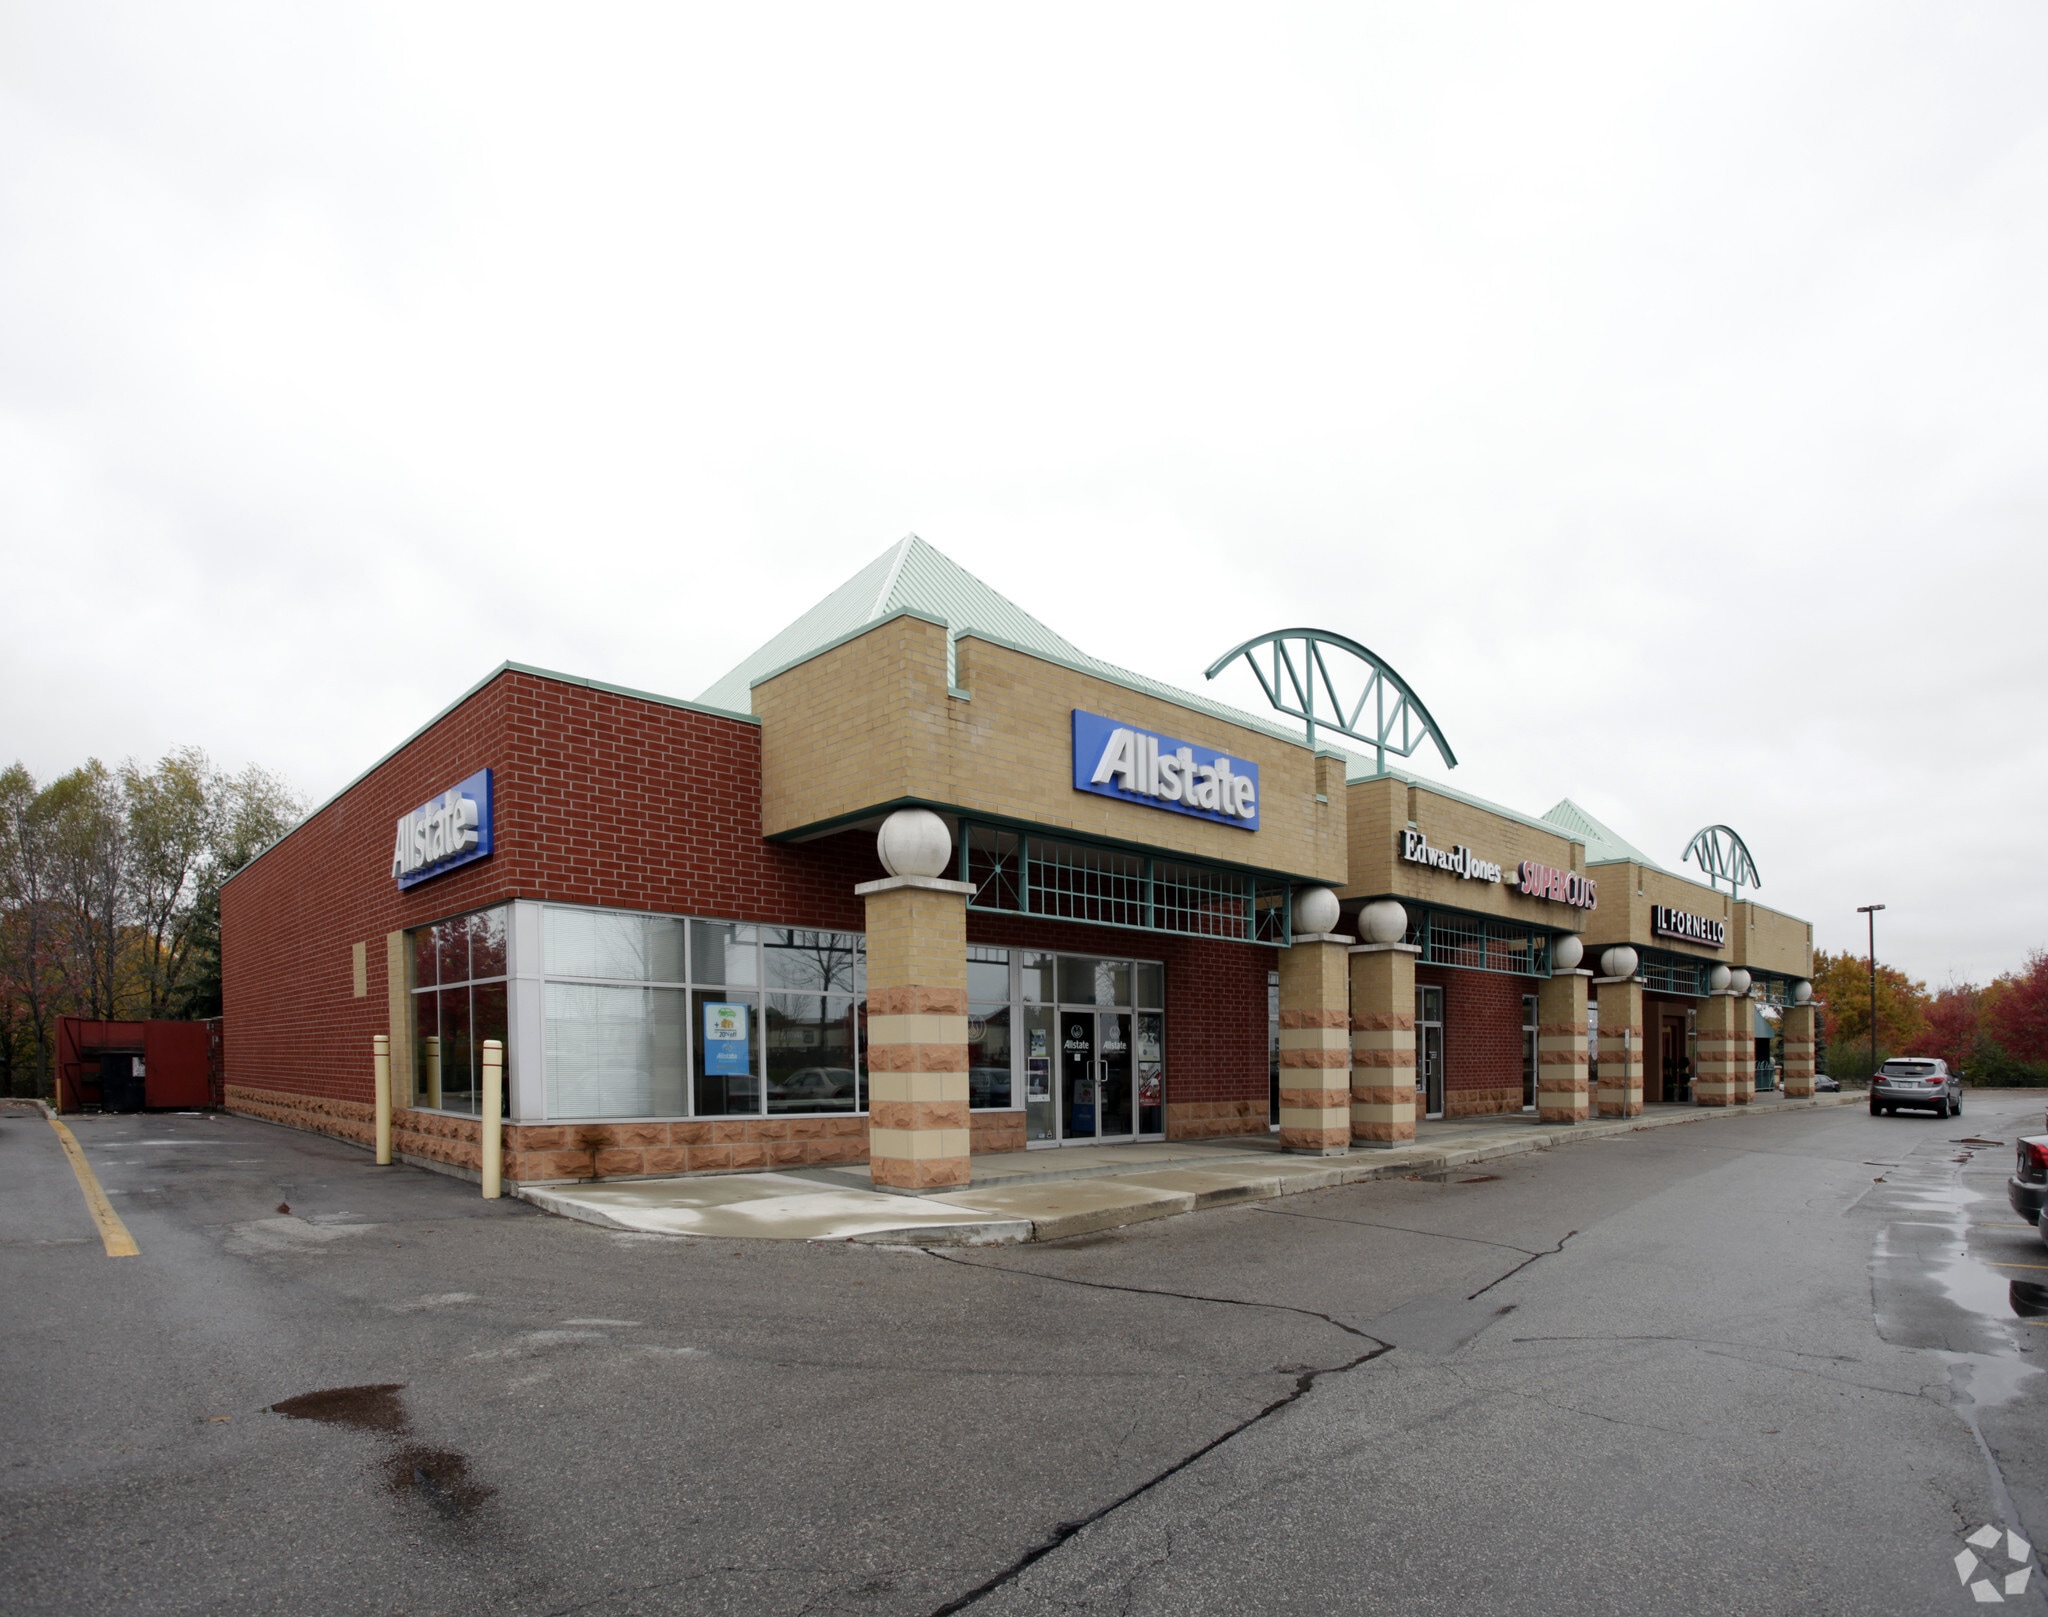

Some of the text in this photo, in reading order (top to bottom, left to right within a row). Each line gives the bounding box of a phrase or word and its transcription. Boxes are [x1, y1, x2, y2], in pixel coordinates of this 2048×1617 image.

[1091, 727, 1255, 819] Allstate
[391, 788, 479, 879] Allstate
[1402, 829, 1501, 883] Edward Jones
[1519, 860, 1598, 910] SUPERCUTS
[1657, 905, 1725, 943] IL FORNELLO
[1064, 1040, 1089, 1050] Allstate
[1103, 1041, 1127, 1050] Allstate
